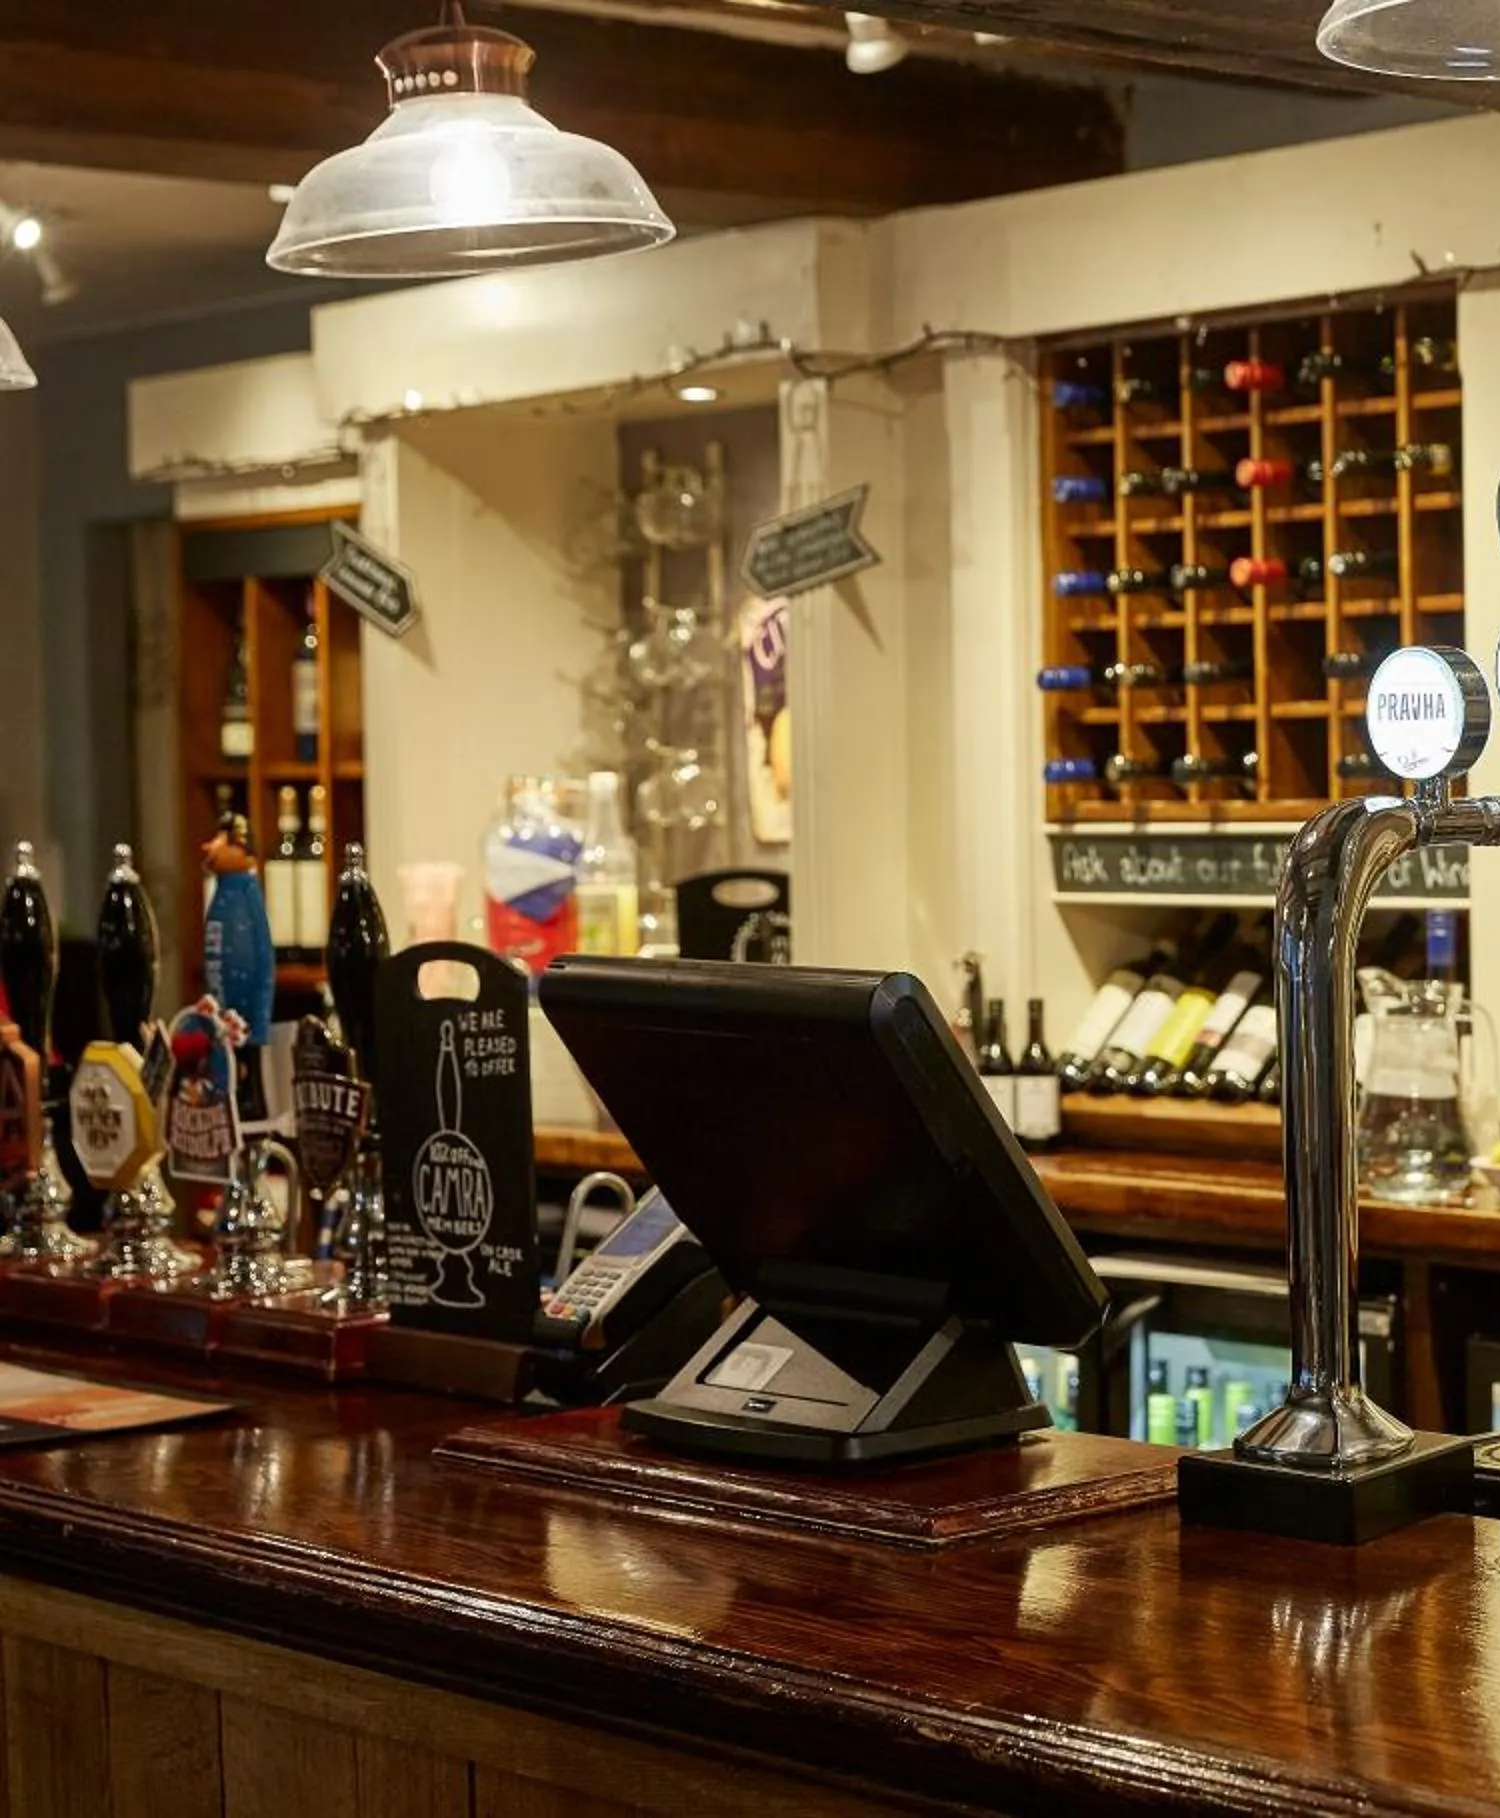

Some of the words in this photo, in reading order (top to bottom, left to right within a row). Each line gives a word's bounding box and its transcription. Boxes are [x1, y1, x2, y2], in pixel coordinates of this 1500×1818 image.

[1376, 692, 1447, 722] PRAVHA
[1062, 840, 1109, 883] Ask
[419, 1164, 487, 1221] CAMRA
